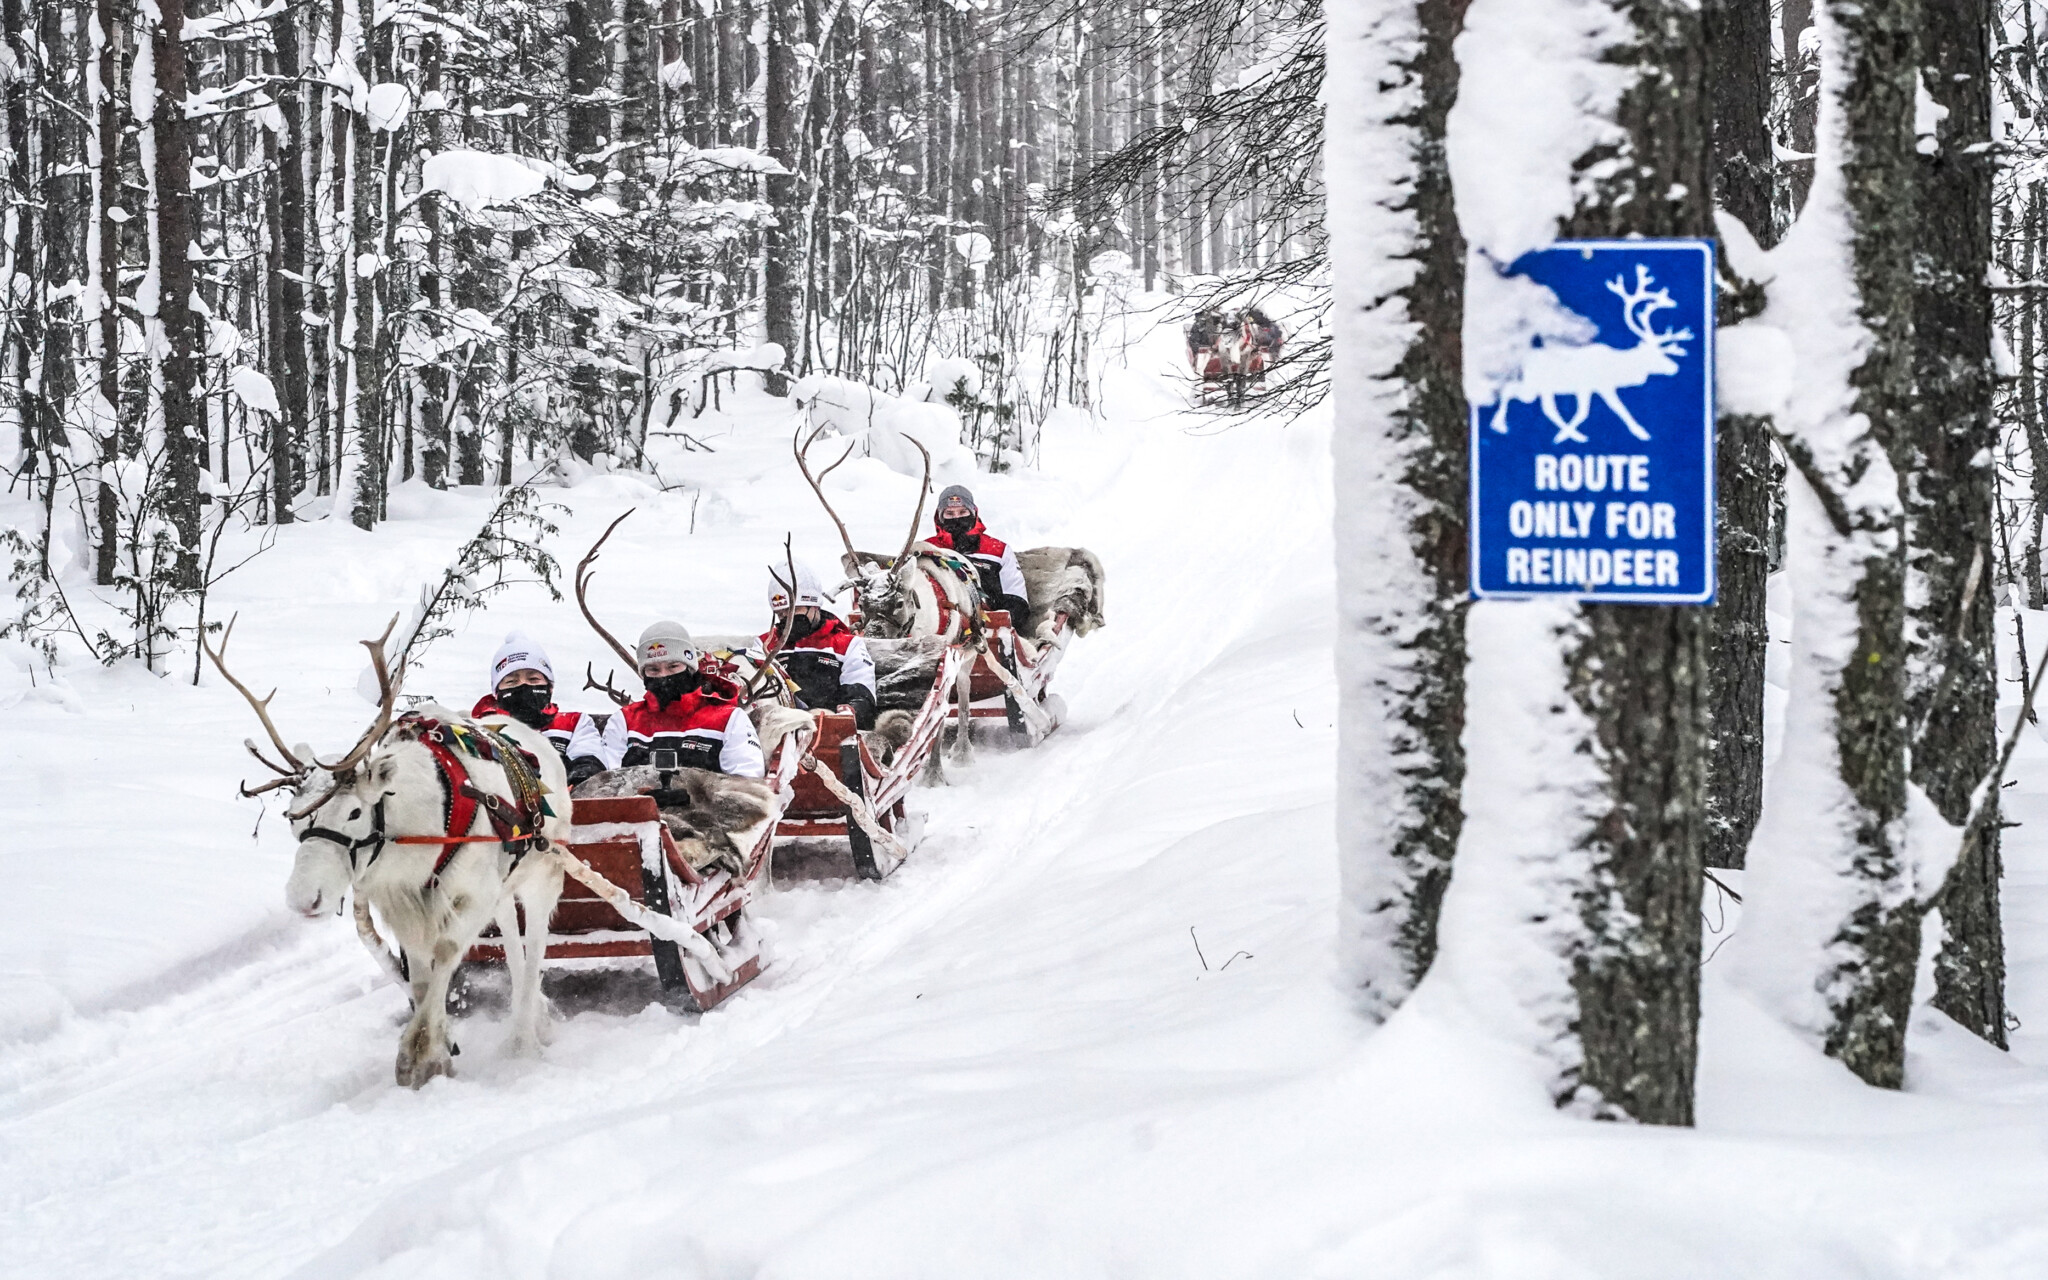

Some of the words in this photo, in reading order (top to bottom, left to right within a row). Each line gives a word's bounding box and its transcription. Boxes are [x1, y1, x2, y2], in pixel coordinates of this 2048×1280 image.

[1535, 454, 1650, 492] ROUTE
[1508, 500, 1596, 538] ONLY
[1606, 501, 1676, 539] FOR
[1506, 547, 1680, 587] REINDEER
